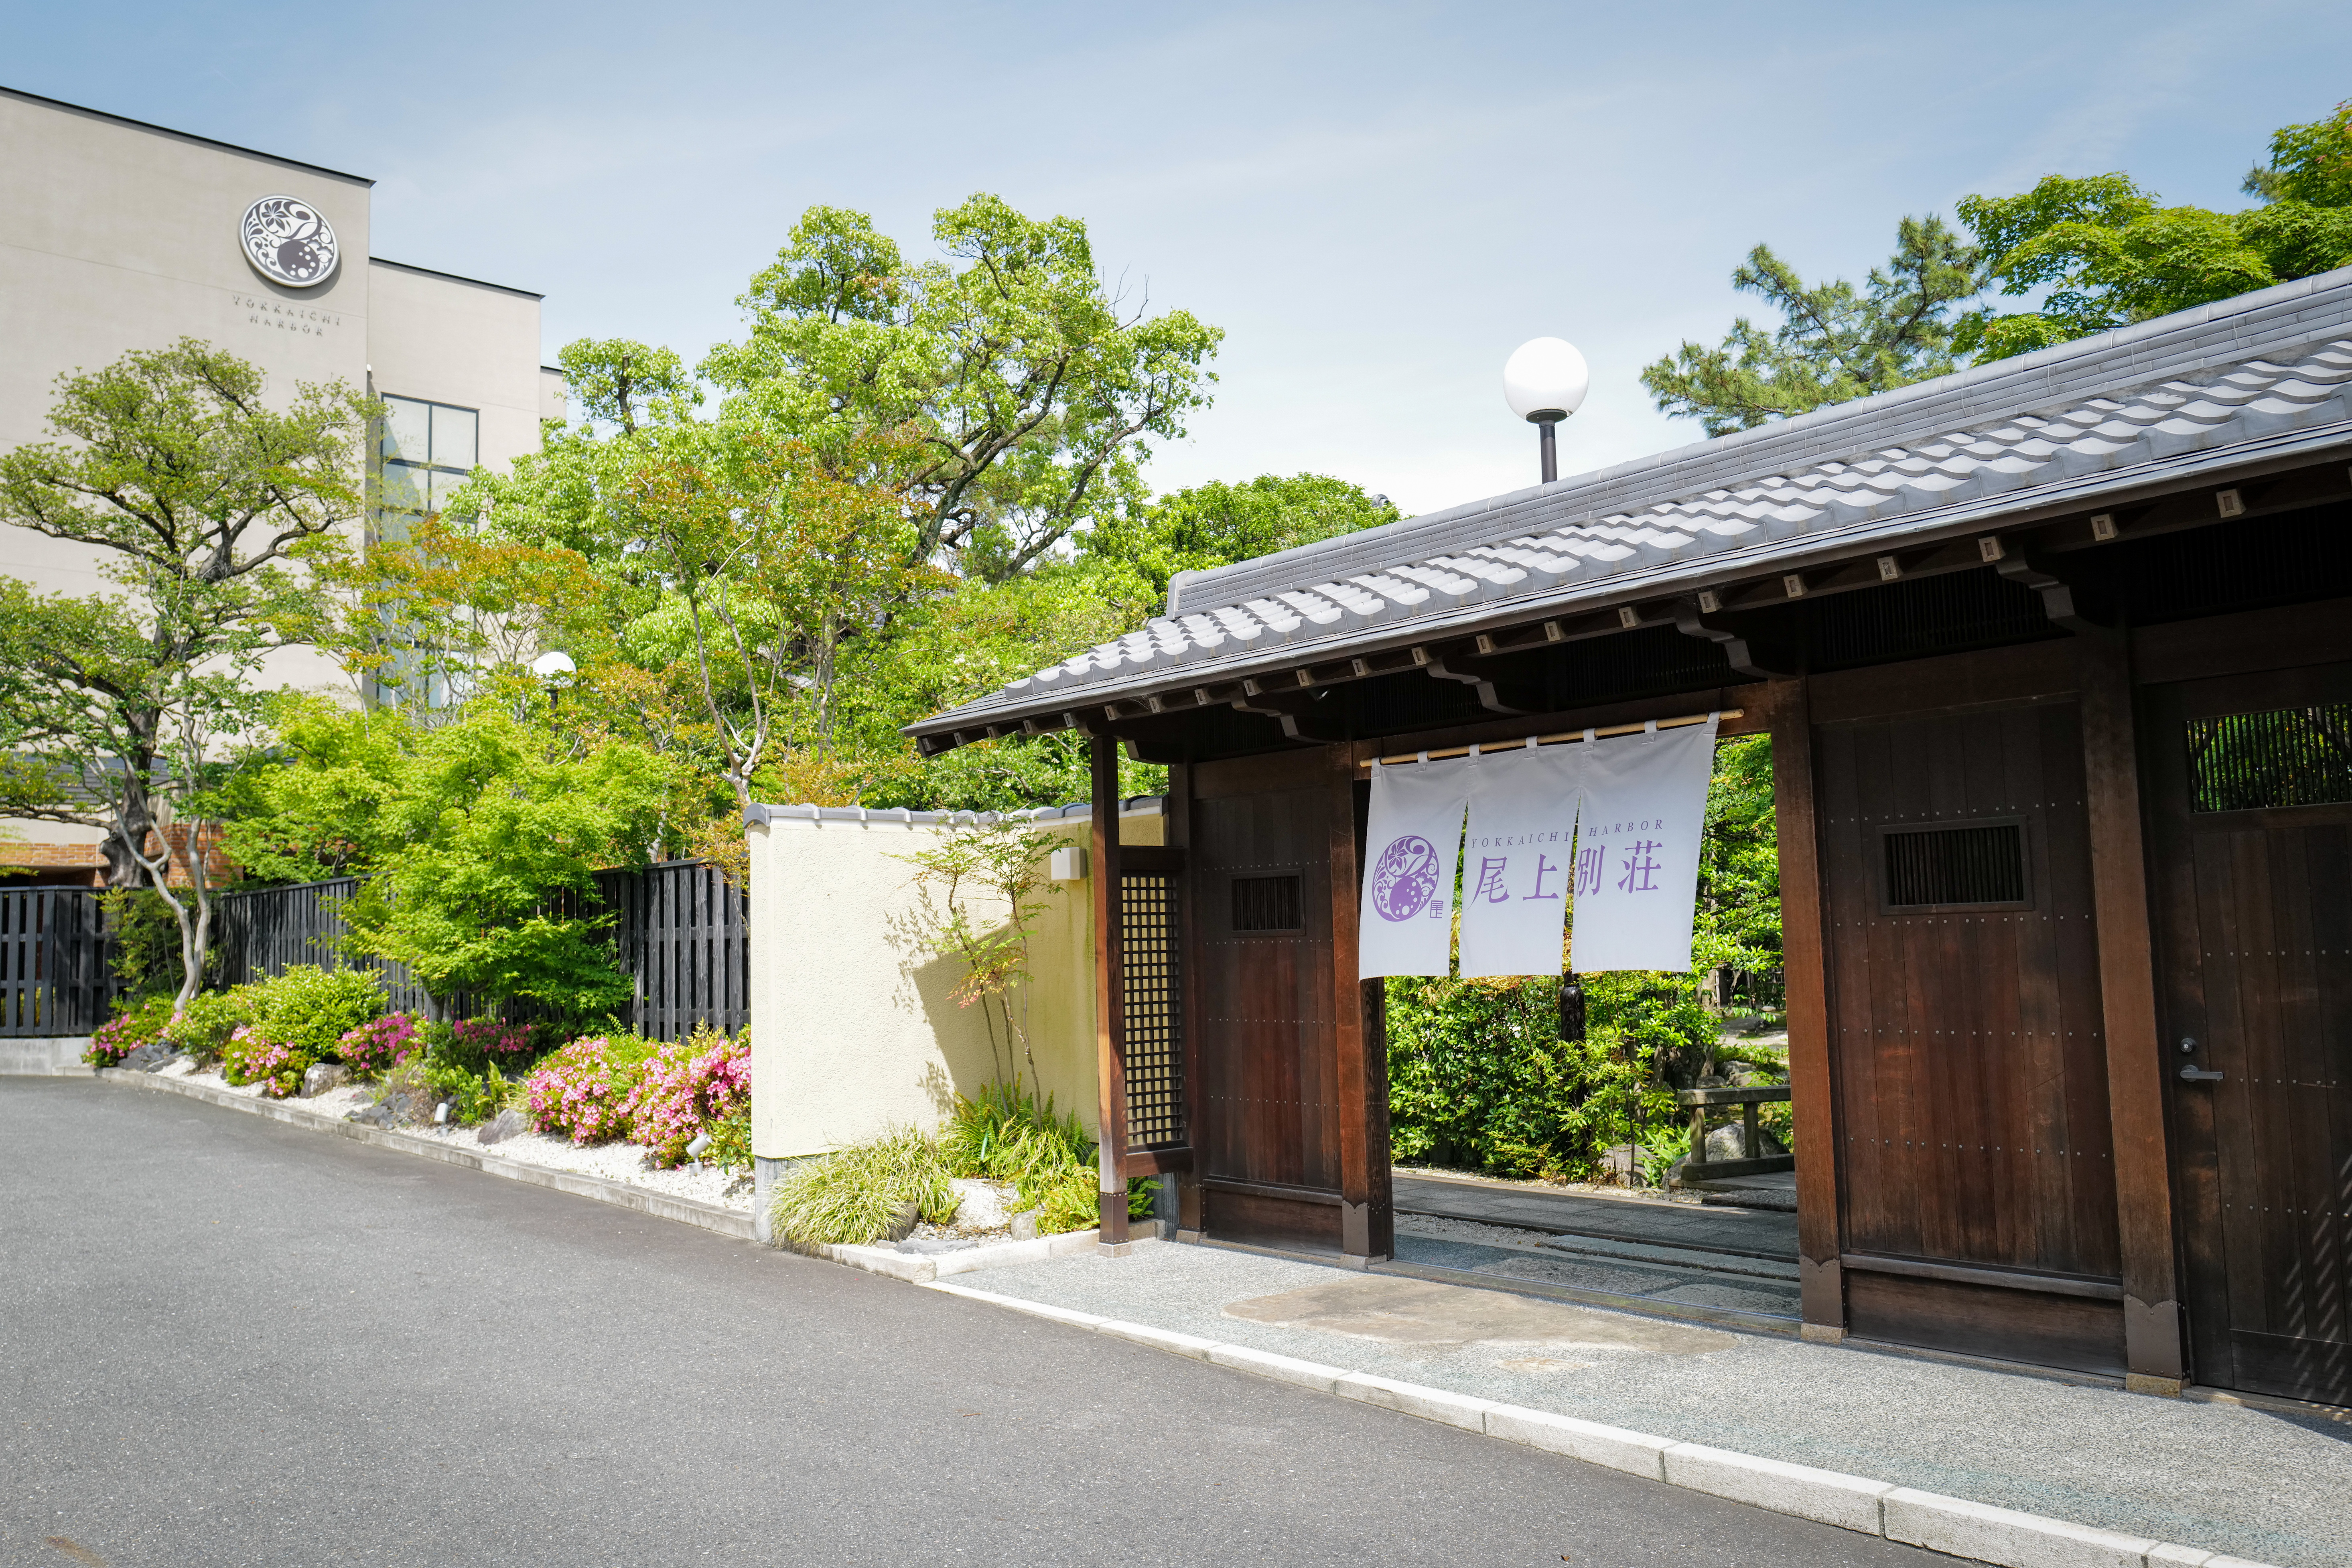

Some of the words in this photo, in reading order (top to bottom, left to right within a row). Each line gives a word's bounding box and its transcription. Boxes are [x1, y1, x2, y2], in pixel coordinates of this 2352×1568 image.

[233, 294, 340, 326] YOKKAICHI
[249, 312, 323, 337] HARBOR
[1471, 832, 1569, 848] YOKKAICHI
[1588, 819, 1663, 836] HARBOR
[1467, 840, 1663, 910] 尾上別荘
